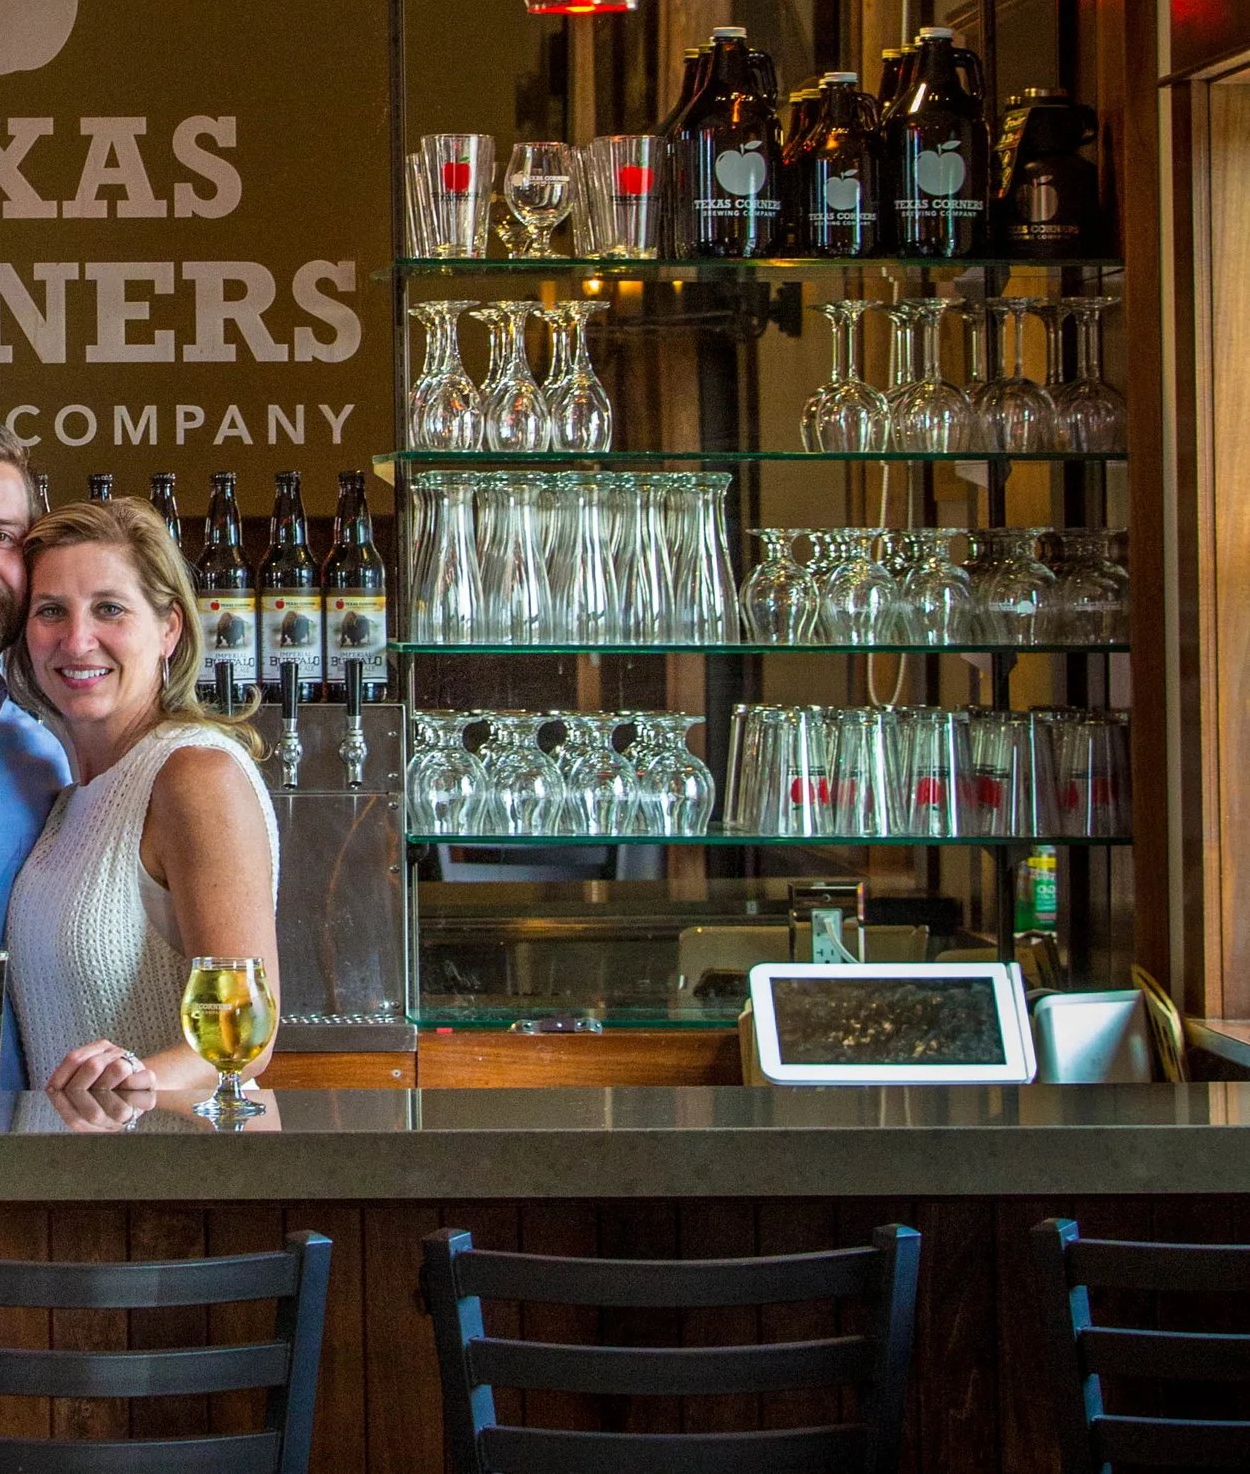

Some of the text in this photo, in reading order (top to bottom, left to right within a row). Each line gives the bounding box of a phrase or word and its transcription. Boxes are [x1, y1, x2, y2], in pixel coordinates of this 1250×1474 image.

[694, 199, 732, 209] TEXAS
[894, 199, 984, 210] TEXAS CORNERS
[5, 404, 355, 448] COMPANY
